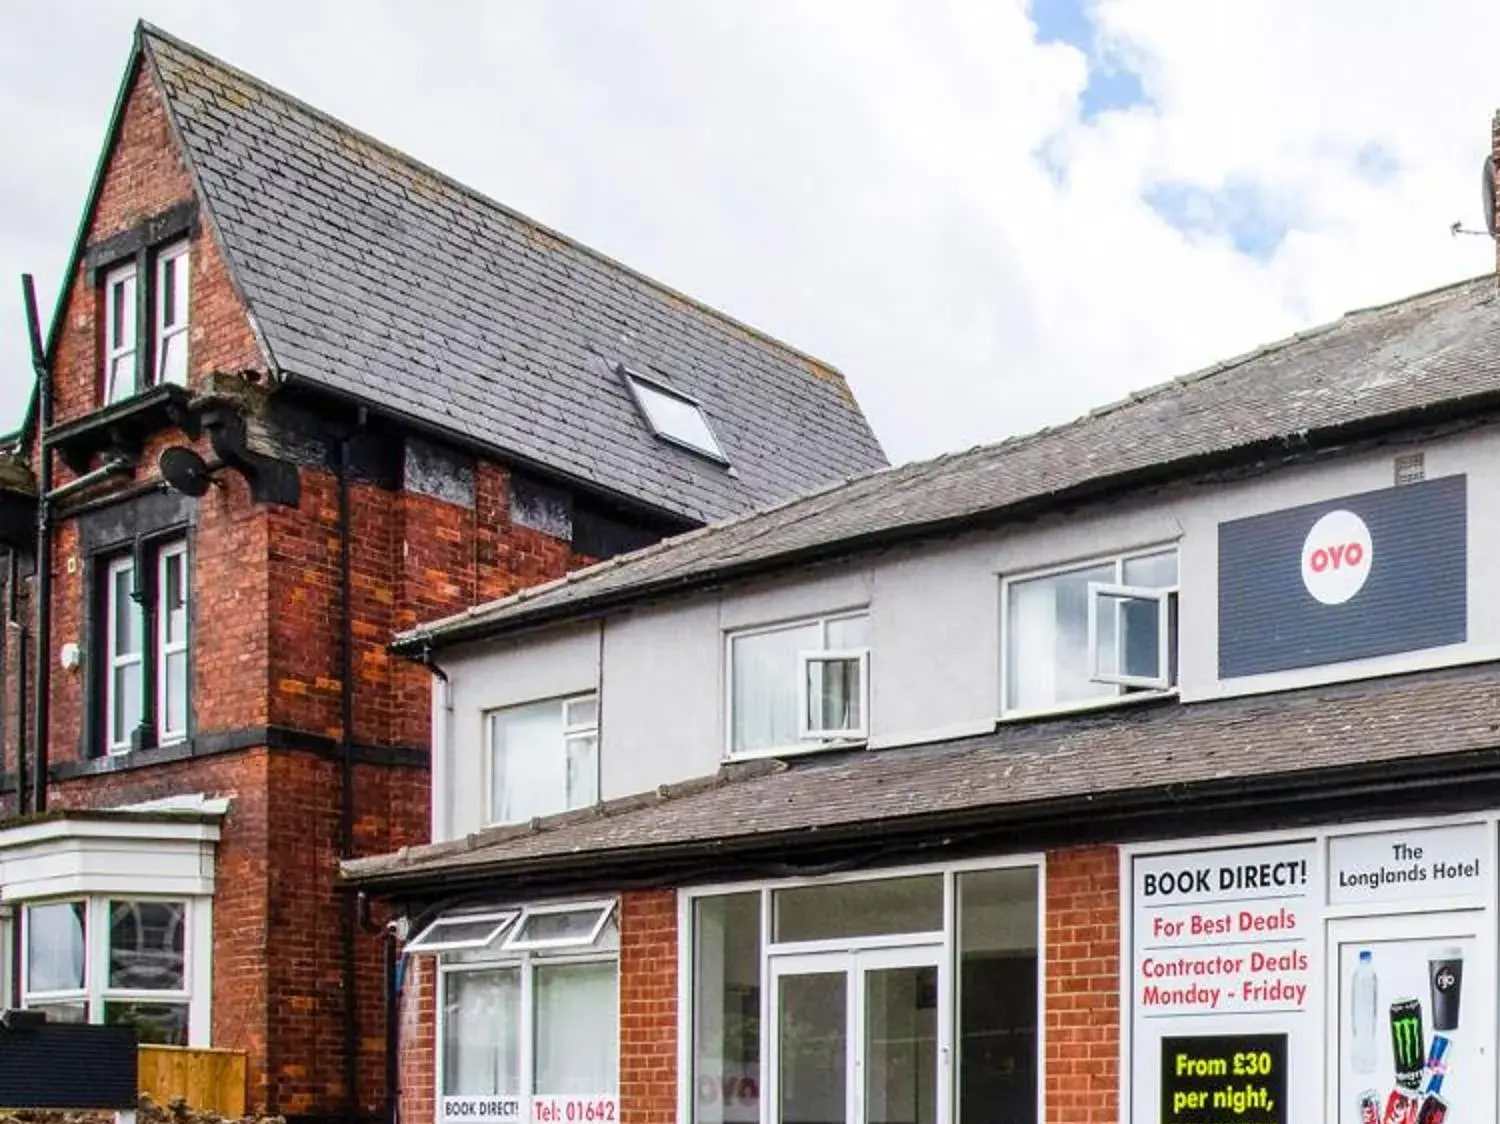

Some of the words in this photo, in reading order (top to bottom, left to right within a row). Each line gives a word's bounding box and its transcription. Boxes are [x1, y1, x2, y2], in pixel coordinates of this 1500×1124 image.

[1310, 543, 1363, 572] OYO
[1392, 843, 1423, 860] The
[1143, 868, 1211, 896] BOOK
[1219, 860, 1307, 890] DIRECT!
[1339, 863, 1427, 888] Longlands
[1433, 858, 1479, 879] Hotel
[1153, 917, 1184, 937] For
[1191, 914, 1232, 935] Best
[1239, 908, 1296, 931] Deals
[1142, 955, 1243, 978] Contractor
[1250, 950, 1308, 972] Deals
[1142, 982, 1220, 1008] Monday
[1242, 978, 1307, 1005] Friday
[1175, 1054, 1227, 1076] From
[1233, 1053, 1272, 1076] £30
[445, 1101, 476, 1116] BOOK
[479, 1100, 519, 1117] DIRECT!
[535, 1101, 561, 1121] Tel:
[565, 1101, 615, 1121] 01642
[1173, 1091, 1208, 1113] per
[1213, 1085, 1274, 1113] night,
